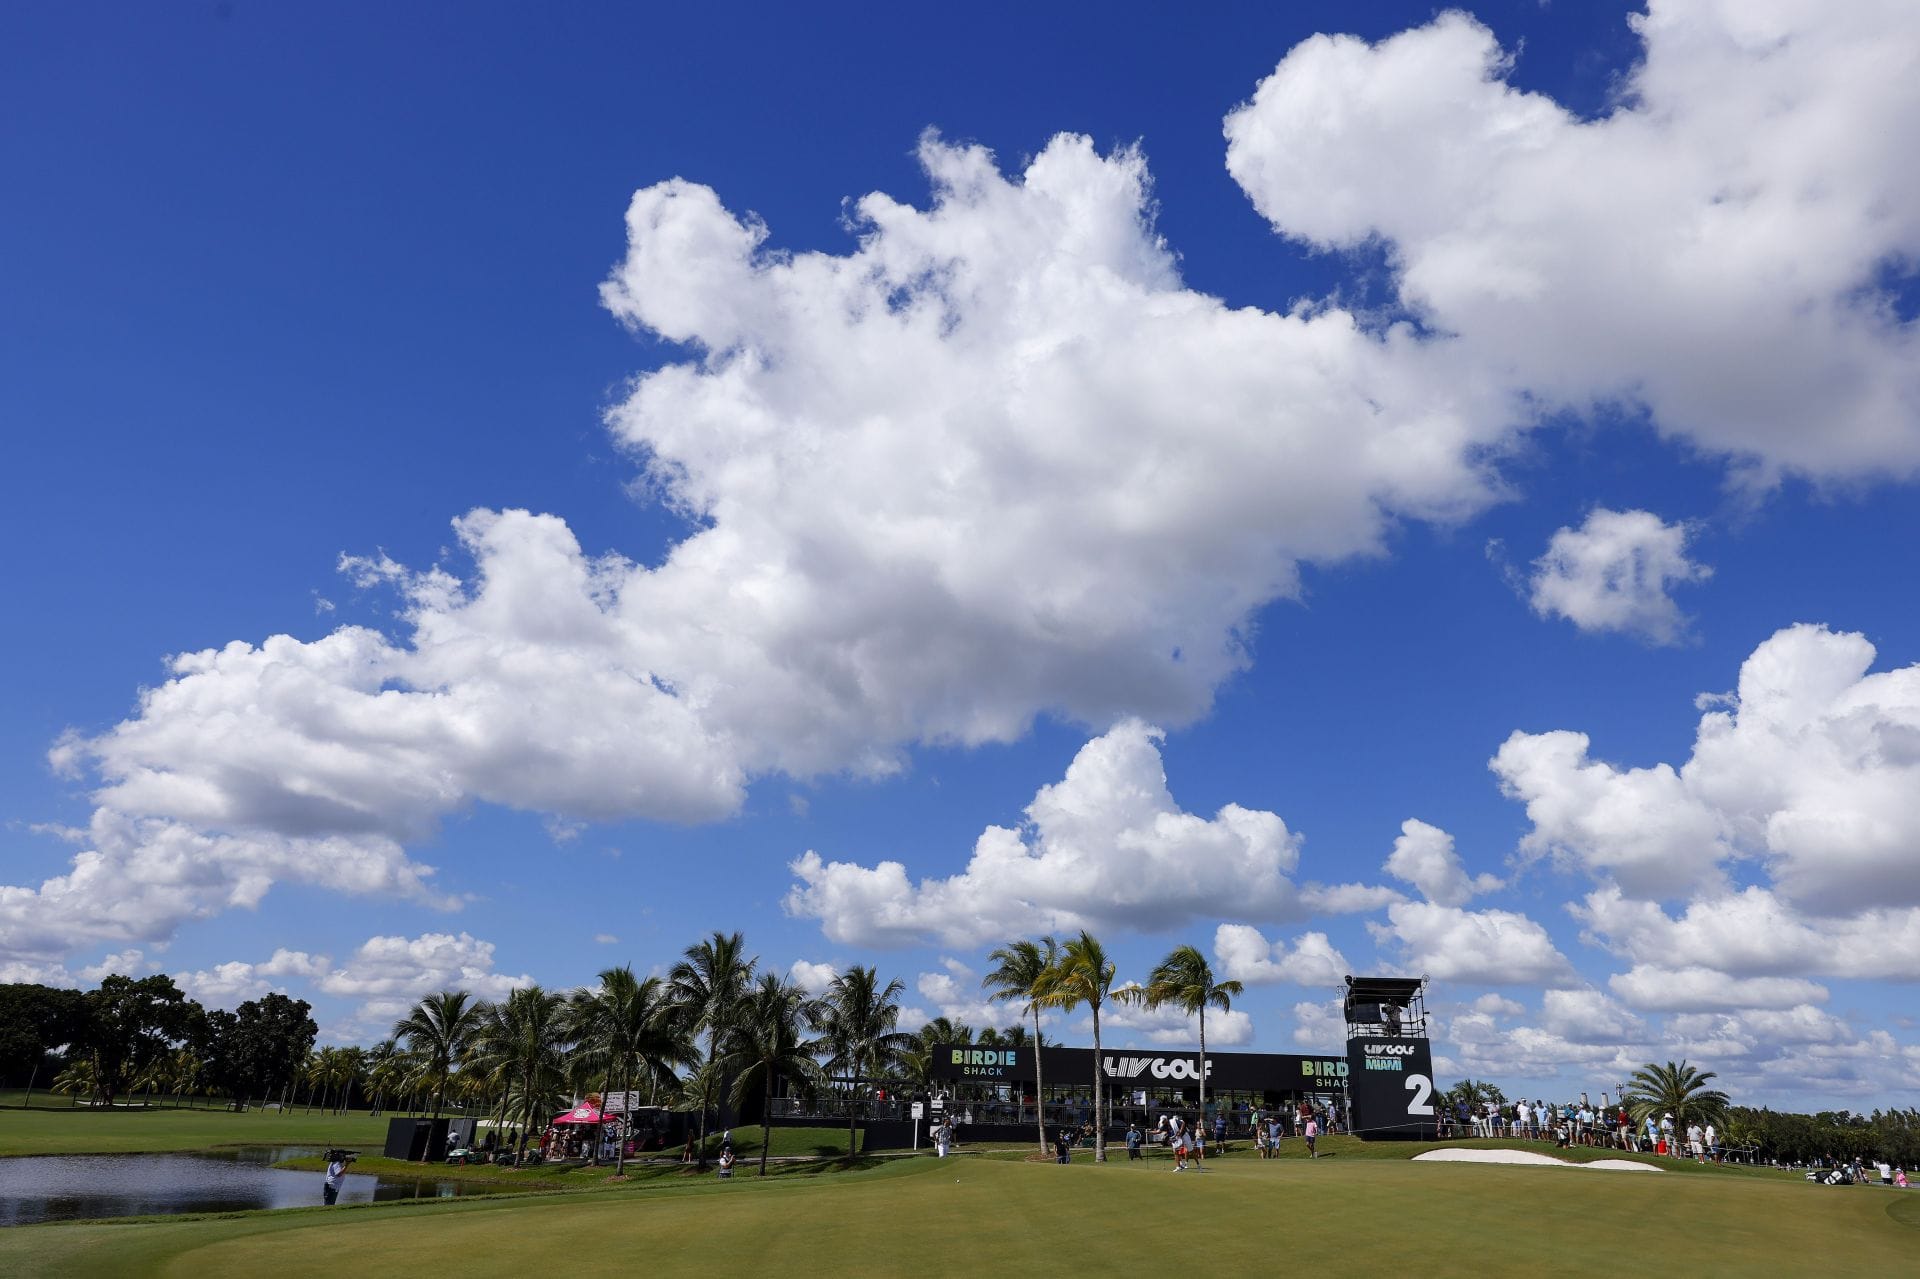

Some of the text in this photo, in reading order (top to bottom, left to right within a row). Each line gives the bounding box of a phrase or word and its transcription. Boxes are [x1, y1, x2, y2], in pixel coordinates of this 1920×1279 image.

[1364, 1044, 1415, 1055] LIV GOLF
[952, 1049, 1016, 1065] BIRDIE
[963, 1066, 1003, 1076] SHACK
[1103, 1056, 1153, 1077] LIV
[1365, 1059, 1402, 1071] MIAMI
[1405, 1073, 1434, 1116] 2
